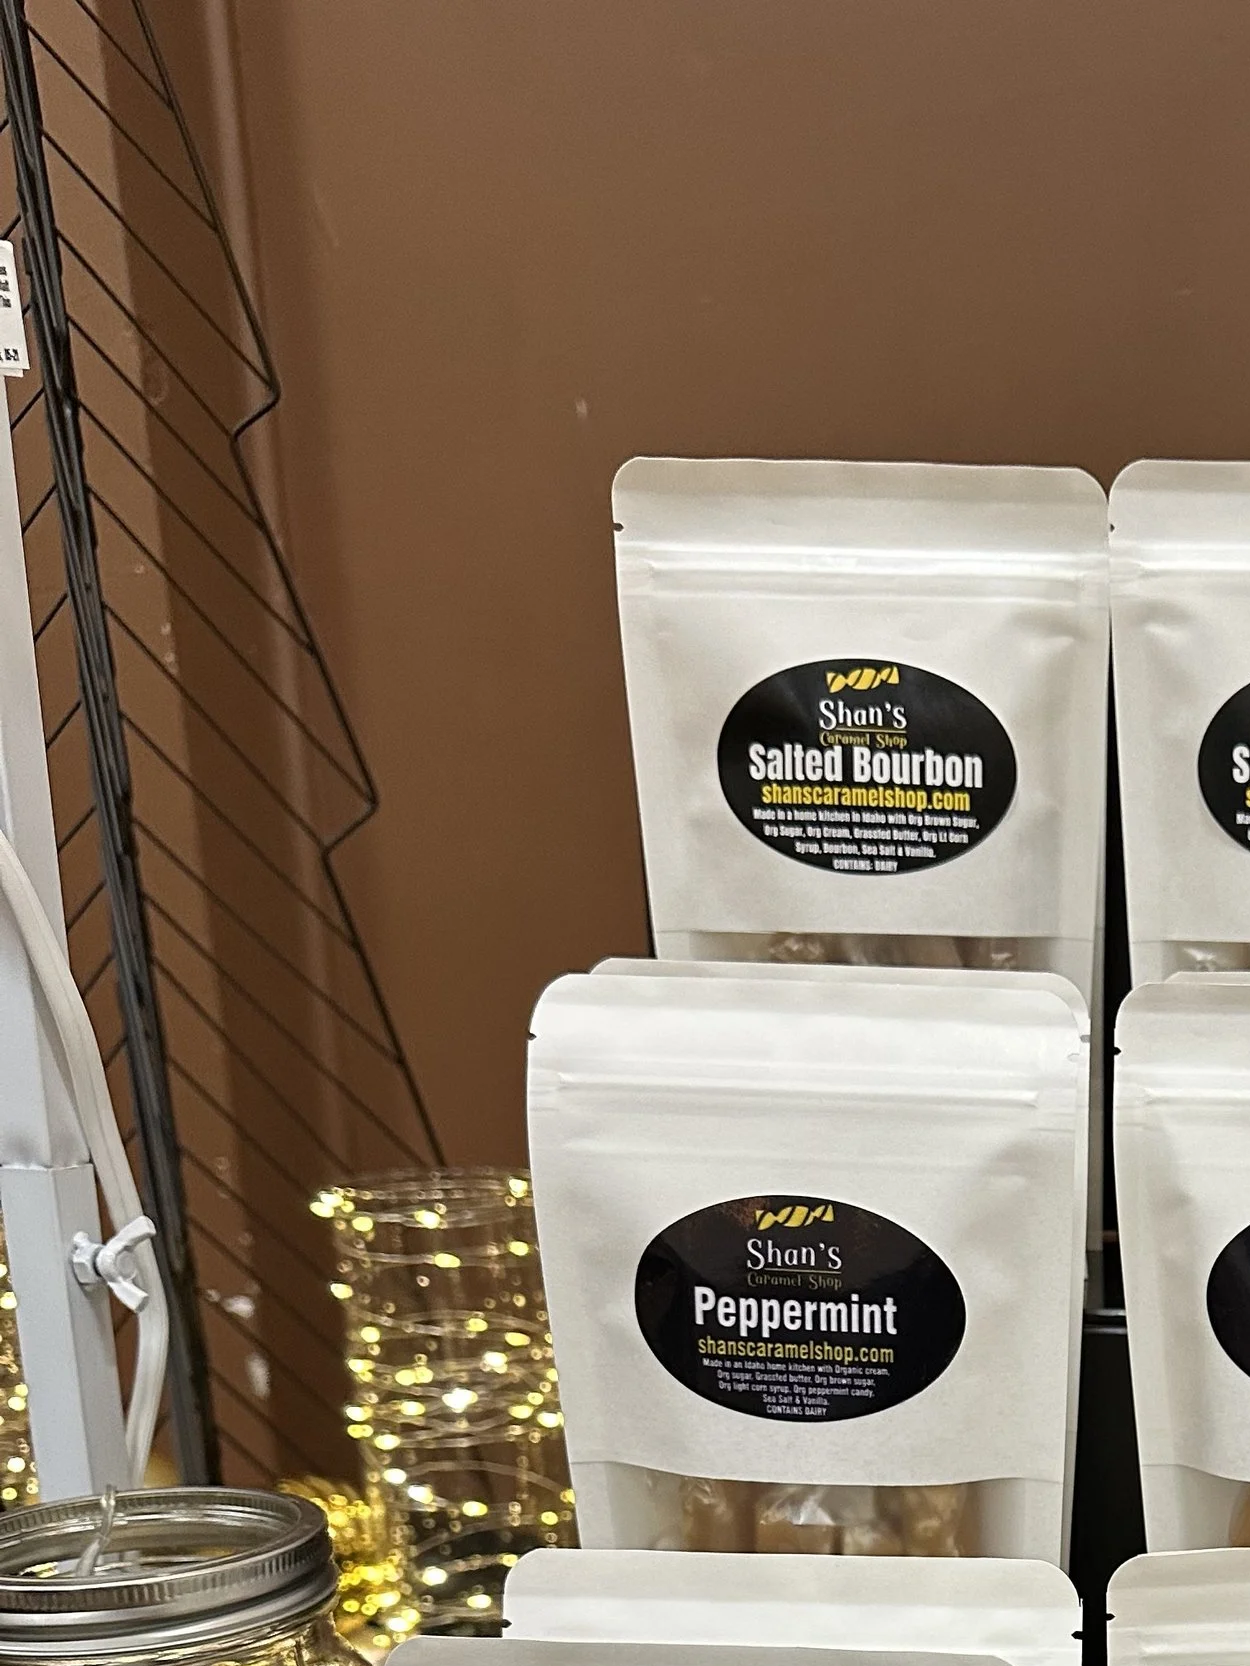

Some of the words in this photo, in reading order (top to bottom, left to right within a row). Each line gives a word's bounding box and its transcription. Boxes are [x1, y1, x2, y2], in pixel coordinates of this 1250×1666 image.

[818, 699, 906, 730] Shan's
[819, 730, 869, 748] Caramel
[875, 731, 907, 748] Shop
[749, 743, 842, 781] Salted
[852, 745, 982, 788] Bourbon
[761, 782, 970, 811] shanscaramelshop.com
[746, 1238, 841, 1272] Shan's
[747, 1272, 800, 1286] Caramel
[808, 1274, 841, 1290] Shop
[694, 1286, 896, 1337] Peppermint
[698, 1335, 893, 1362] shanscaramelshop.com
[766, 1404, 802, 1414] CONTAINS
[804, 1406, 826, 1415] DAIRY
